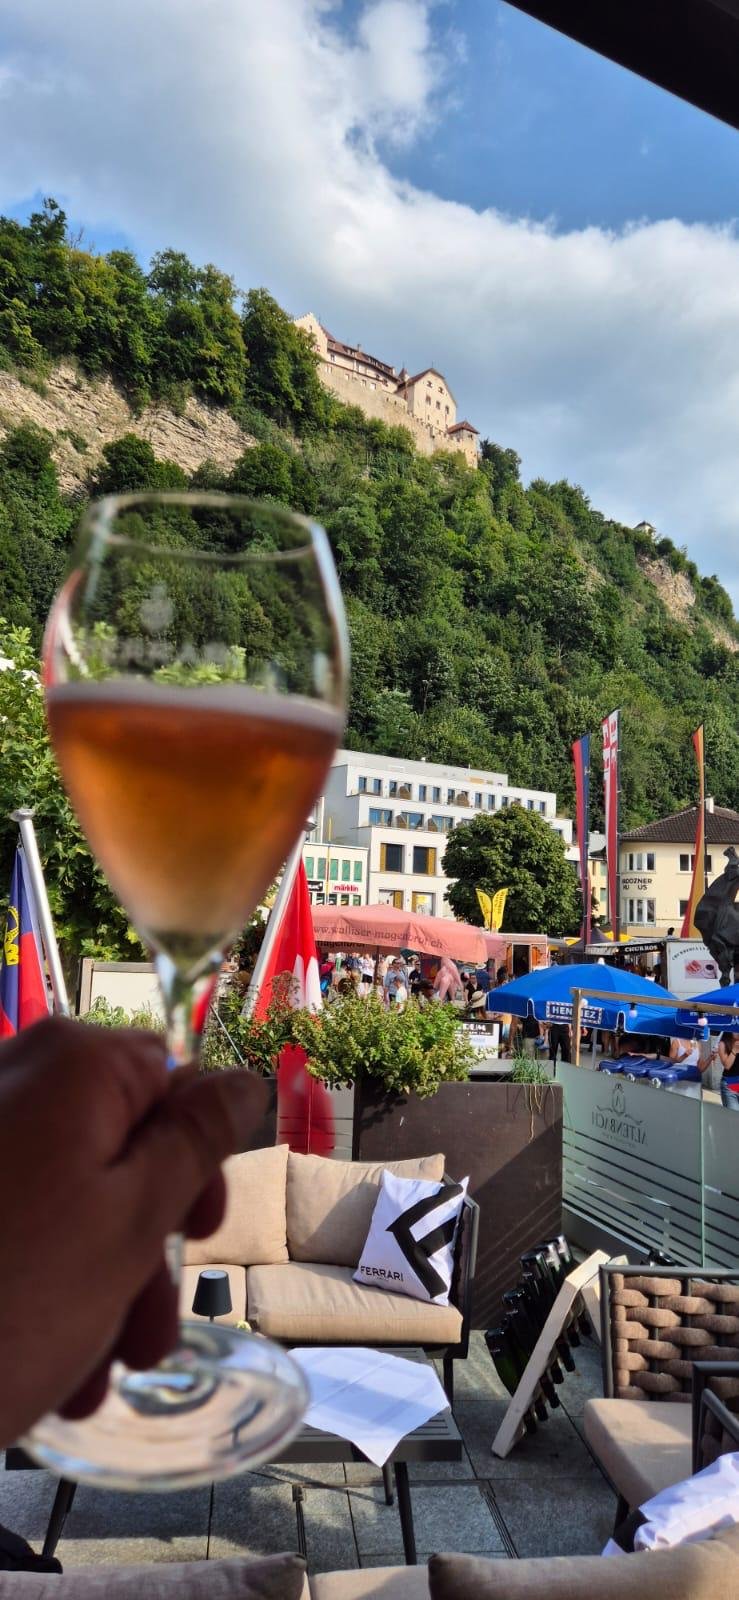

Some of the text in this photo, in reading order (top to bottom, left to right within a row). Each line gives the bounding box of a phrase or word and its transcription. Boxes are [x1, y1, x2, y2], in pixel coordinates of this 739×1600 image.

[334, 884, 359, 892] märklin
[624, 945, 658, 953] CHURROS
[360, 1265, 404, 1282] FERRARI
